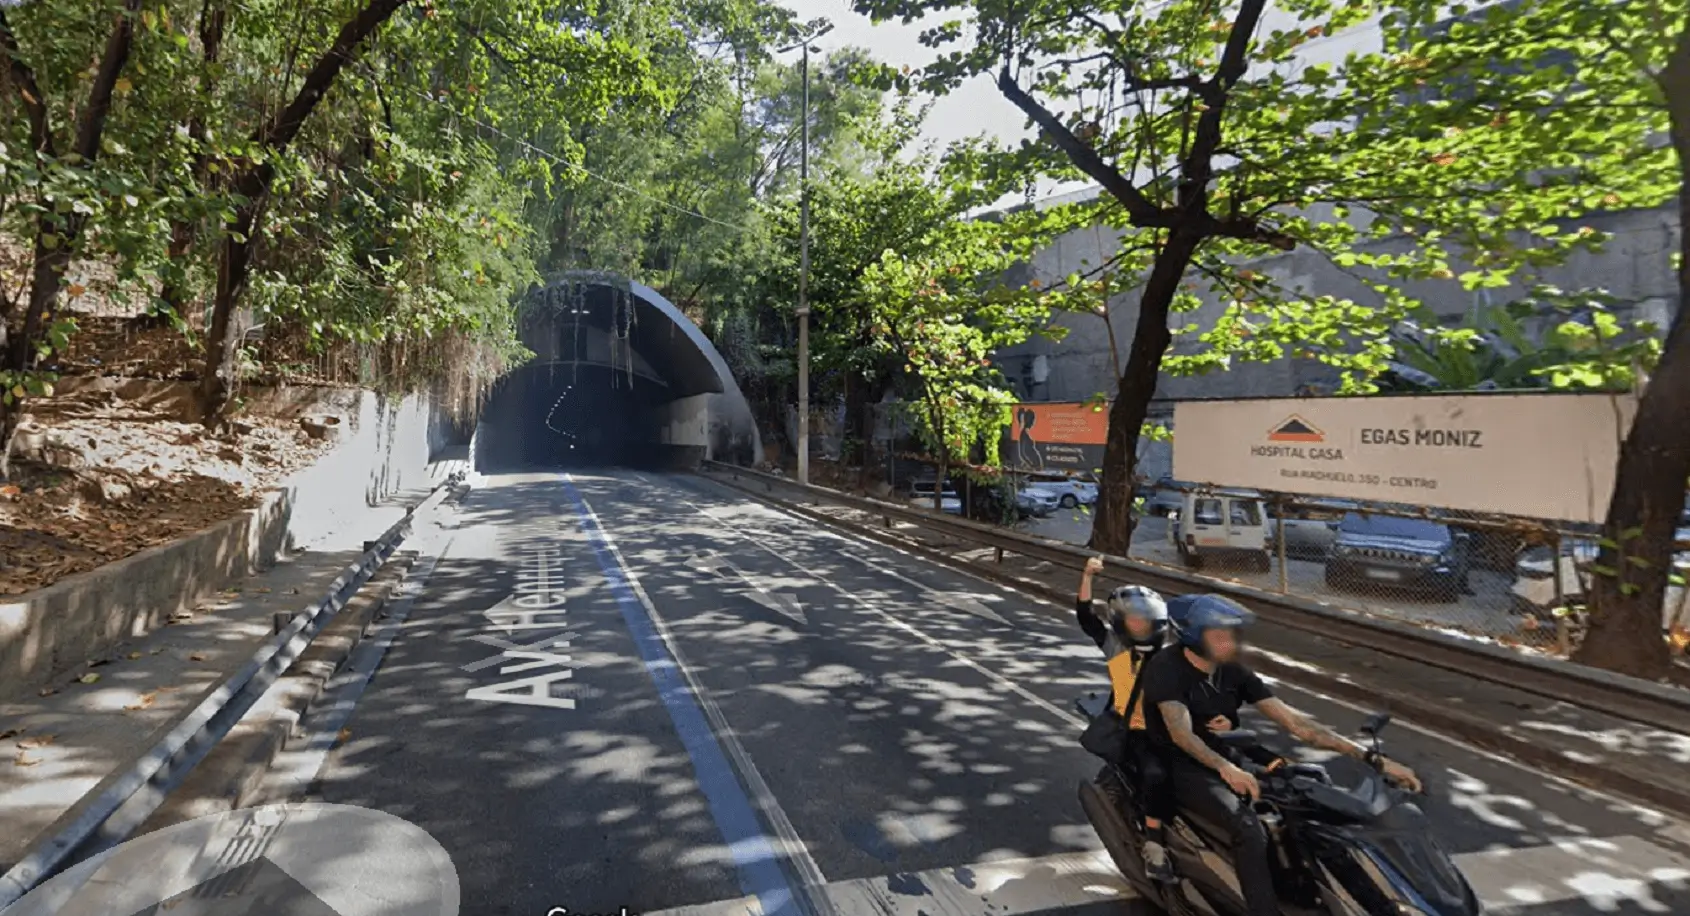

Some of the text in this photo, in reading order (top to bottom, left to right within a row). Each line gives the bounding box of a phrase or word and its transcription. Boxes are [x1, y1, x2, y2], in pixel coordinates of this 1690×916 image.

[1360, 428, 1483, 448] EGAS MONIZ
[1251, 446, 1344, 461] HOSPITAL CASA
[1389, 476, 1437, 490] CENTRO
